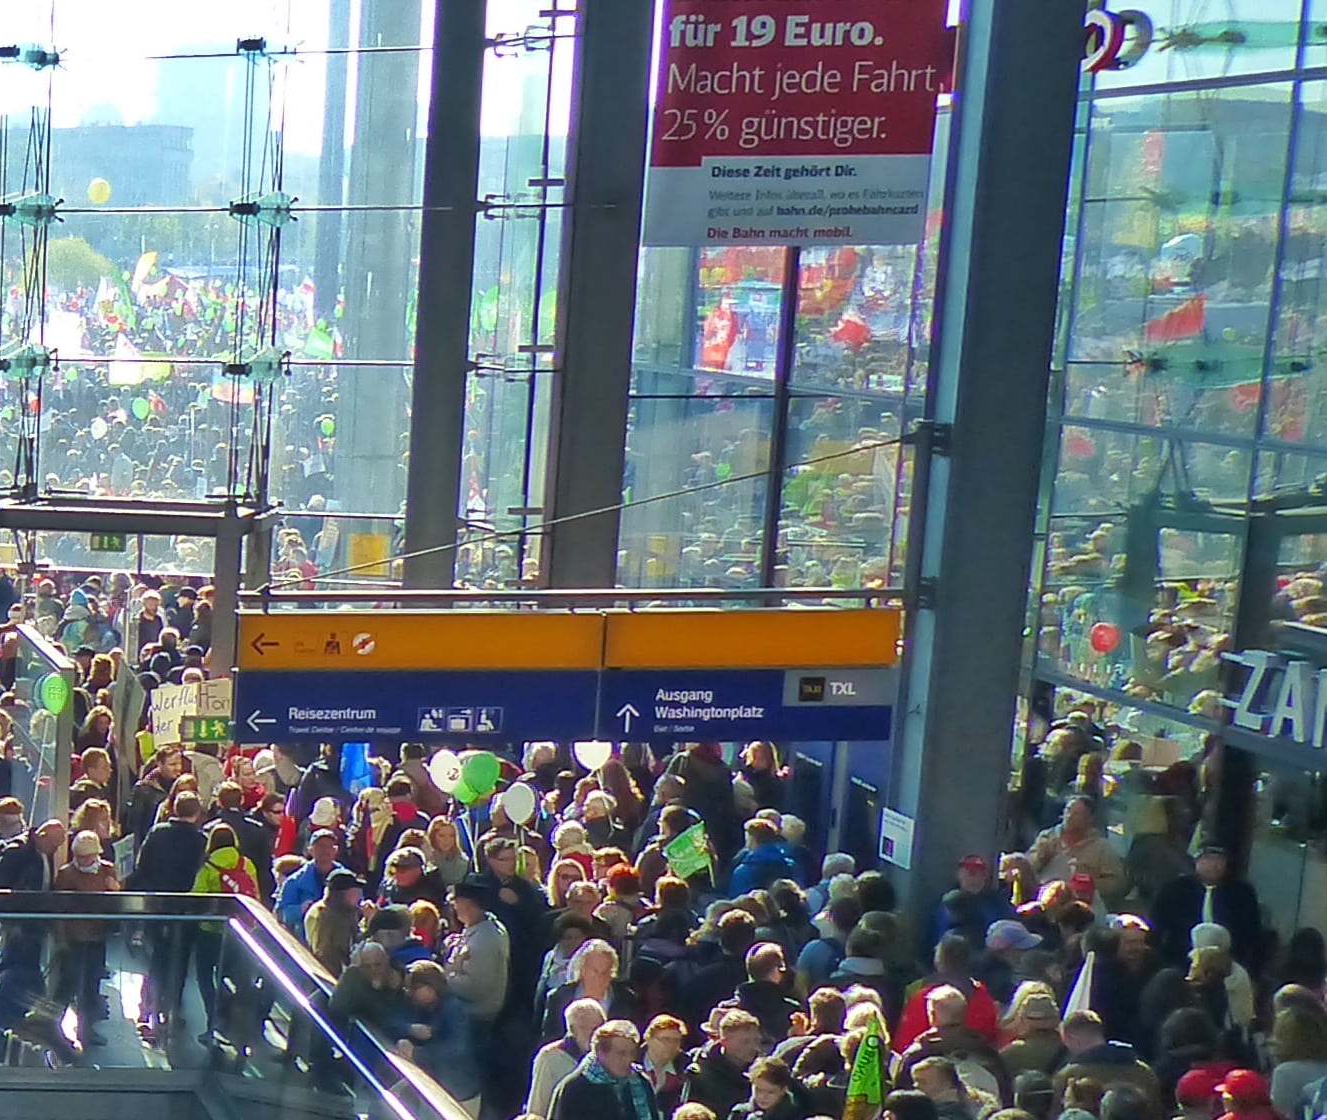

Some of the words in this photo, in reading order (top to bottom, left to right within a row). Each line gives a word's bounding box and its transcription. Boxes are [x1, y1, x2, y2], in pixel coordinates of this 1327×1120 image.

[669, 14, 722, 47] für
[729, 15, 776, 48] 19
[784, 14, 884, 47] Euro.
[666, 61, 766, 94] Macht
[770, 60, 842, 101] jede
[852, 59, 937, 93] Fahrt
[738, 107, 888, 148] günstiger.
[711, 165, 750, 178] Diese
[753, 165, 782, 178] Zeit
[783, 164, 831, 180] gehört
[834, 164, 858, 177] Dir.
[706, 226, 729, 239] Die
[732, 226, 765, 239] Bahn
[768, 227, 810, 239] macht
[812, 225, 854, 238] mobil.
[655, 688, 714, 704] Ausgang
[829, 681, 857, 696] TXL
[288, 706, 377, 720] Reisezentrum
[654, 705, 765, 721] Washingtonplatz
